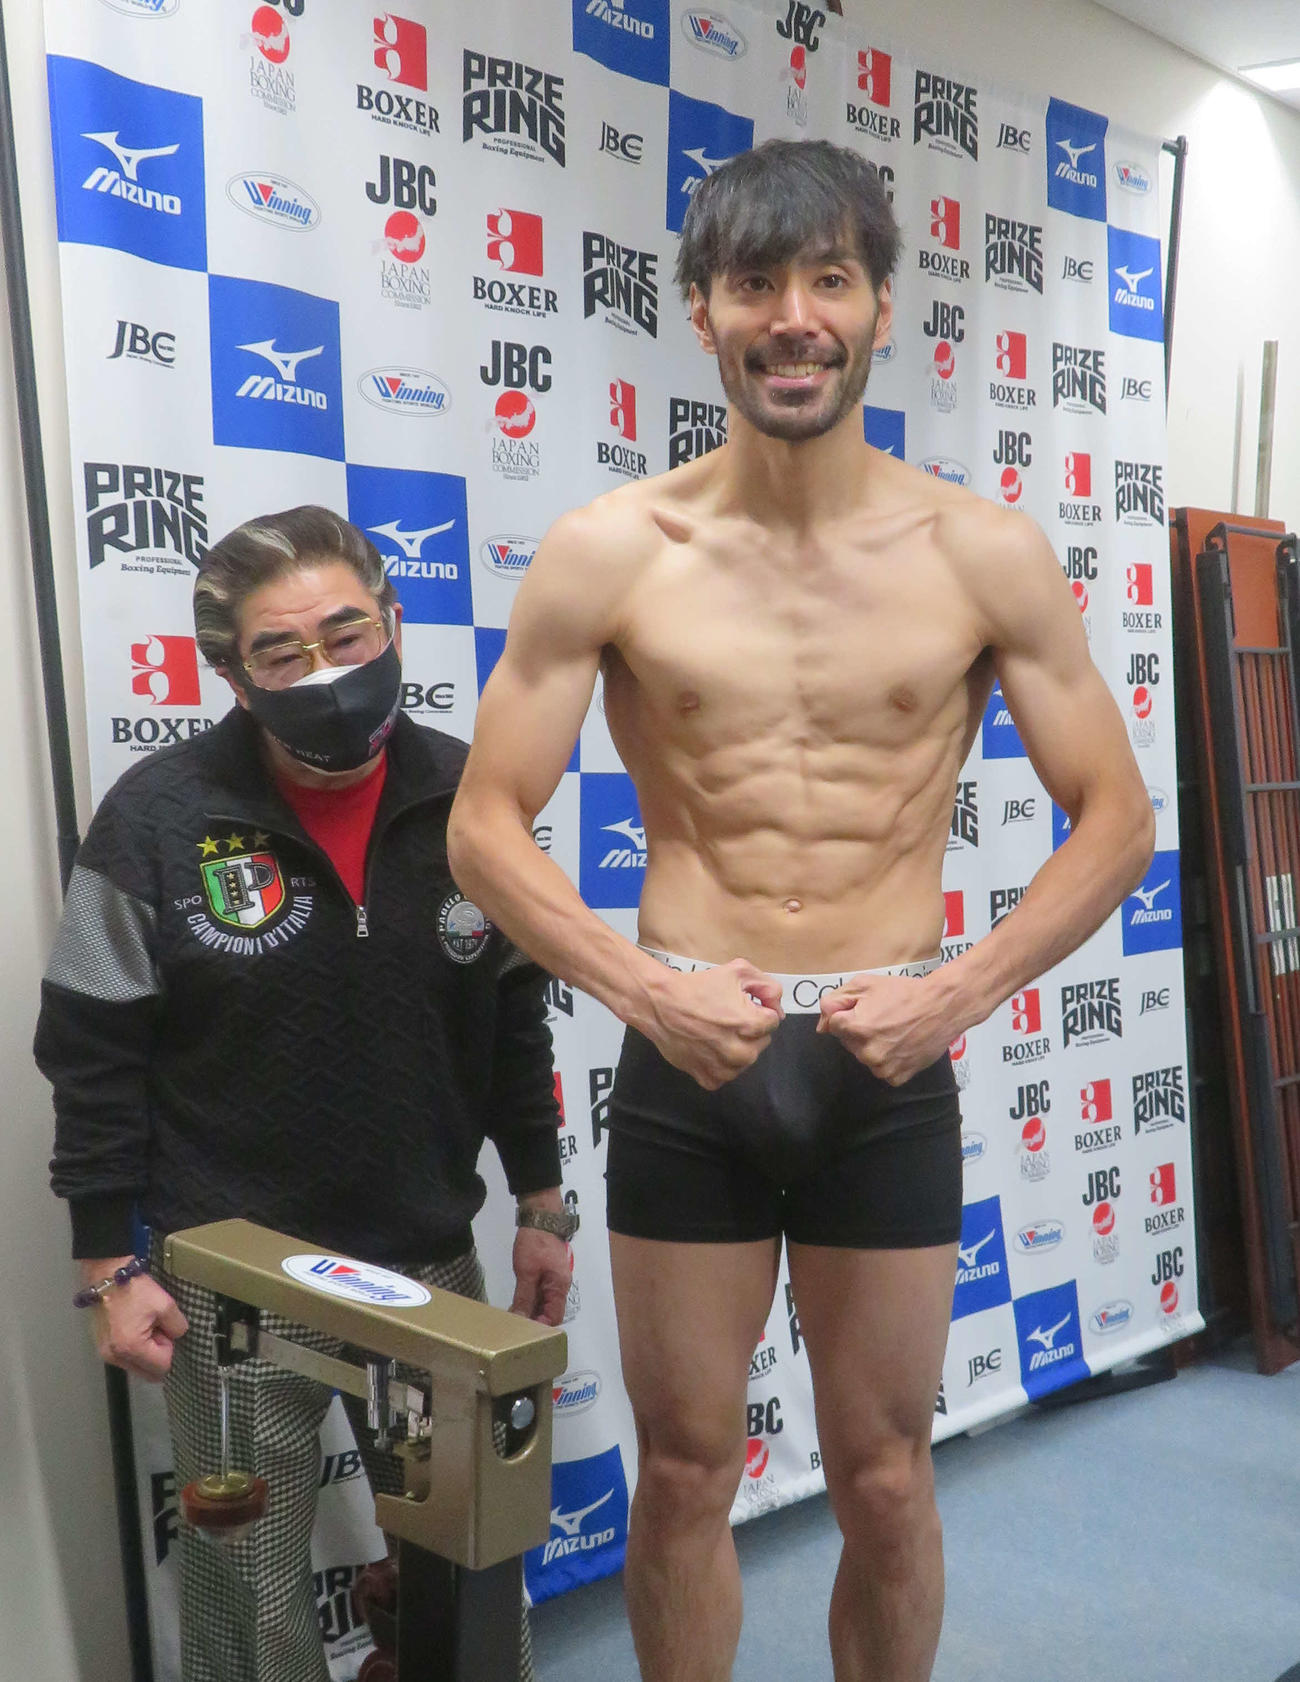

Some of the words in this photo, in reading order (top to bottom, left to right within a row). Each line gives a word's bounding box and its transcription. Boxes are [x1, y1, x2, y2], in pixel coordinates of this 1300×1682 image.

[776, 0, 826, 52] JBC
[250, 55, 295, 88] JAPAN
[250, 71, 296, 102] BOXING
[463, 48, 565, 122] PRIZE
[357, 83, 440, 134] BOXER
[915, 69, 978, 124] PRIZE
[463, 88, 566, 168] RING
[846, 103, 901, 139] BOXER
[914, 100, 979, 162] RING
[483, 142, 508, 155] Boxing
[243, 179, 312, 226] Winning
[365, 154, 437, 217] JBC
[985, 212, 1043, 259] PRIZE
[381, 260, 430, 281] JAPAN
[583, 231, 658, 300] PRIZE
[919, 250, 970, 280] BOXER
[985, 238, 1043, 296] RING
[1062, 256, 1094, 281] JBC
[381, 272, 431, 299] BOXING
[473, 276, 559, 313] BOXER
[583, 267, 658, 339] RING
[484, 303, 504, 312] HARD
[505, 306, 531, 316] KNOCK
[923, 300, 965, 343] JBC
[106, 320, 176, 363] JBC
[480, 340, 552, 393] JBC
[1052, 342, 1106, 382] PRIZE
[372, 375, 445, 410] Winning
[990, 382, 1037, 407] BOXER
[1053, 366, 1107, 417] RING
[670, 397, 728, 436] PRIZ
[492, 448, 540, 468] BOXING
[493, 437, 539, 454] JAPAN
[597, 441, 648, 475] BOXER
[993, 429, 1032, 468] JBC
[84, 462, 208, 526] PRIZE
[1115, 459, 1163, 494] PRIZE
[1059, 502, 1102, 522] BOXER
[1115, 482, 1165, 528] RING
[121, 563, 155, 574] Boxing
[487, 543, 535, 567] Winni
[1063, 547, 1098, 580] JBC
[1123, 612, 1162, 629] BOXER
[1126, 653, 1159, 686] JBC
[401, 682, 455, 709] BC
[130, 744, 157, 752] HARD
[1002, 799, 1035, 826] JBC
[186, 913, 263, 956] CAMPIONI
[1061, 977, 1121, 1014] PRIZE
[1062, 998, 1123, 1050] RING
[1002, 1038, 1051, 1064] BOXER
[1010, 1079, 1051, 1121] JBC
[1132, 1065, 1183, 1105] PRIZE
[1134, 1090, 1186, 1137] RING
[1074, 1125, 1122, 1152] BOXER
[1082, 1166, 1121, 1206] JBC
[1144, 1207, 1185, 1234] BOXER
[1151, 1246, 1184, 1287] JBC
[746, 1396, 783, 1436] BC
